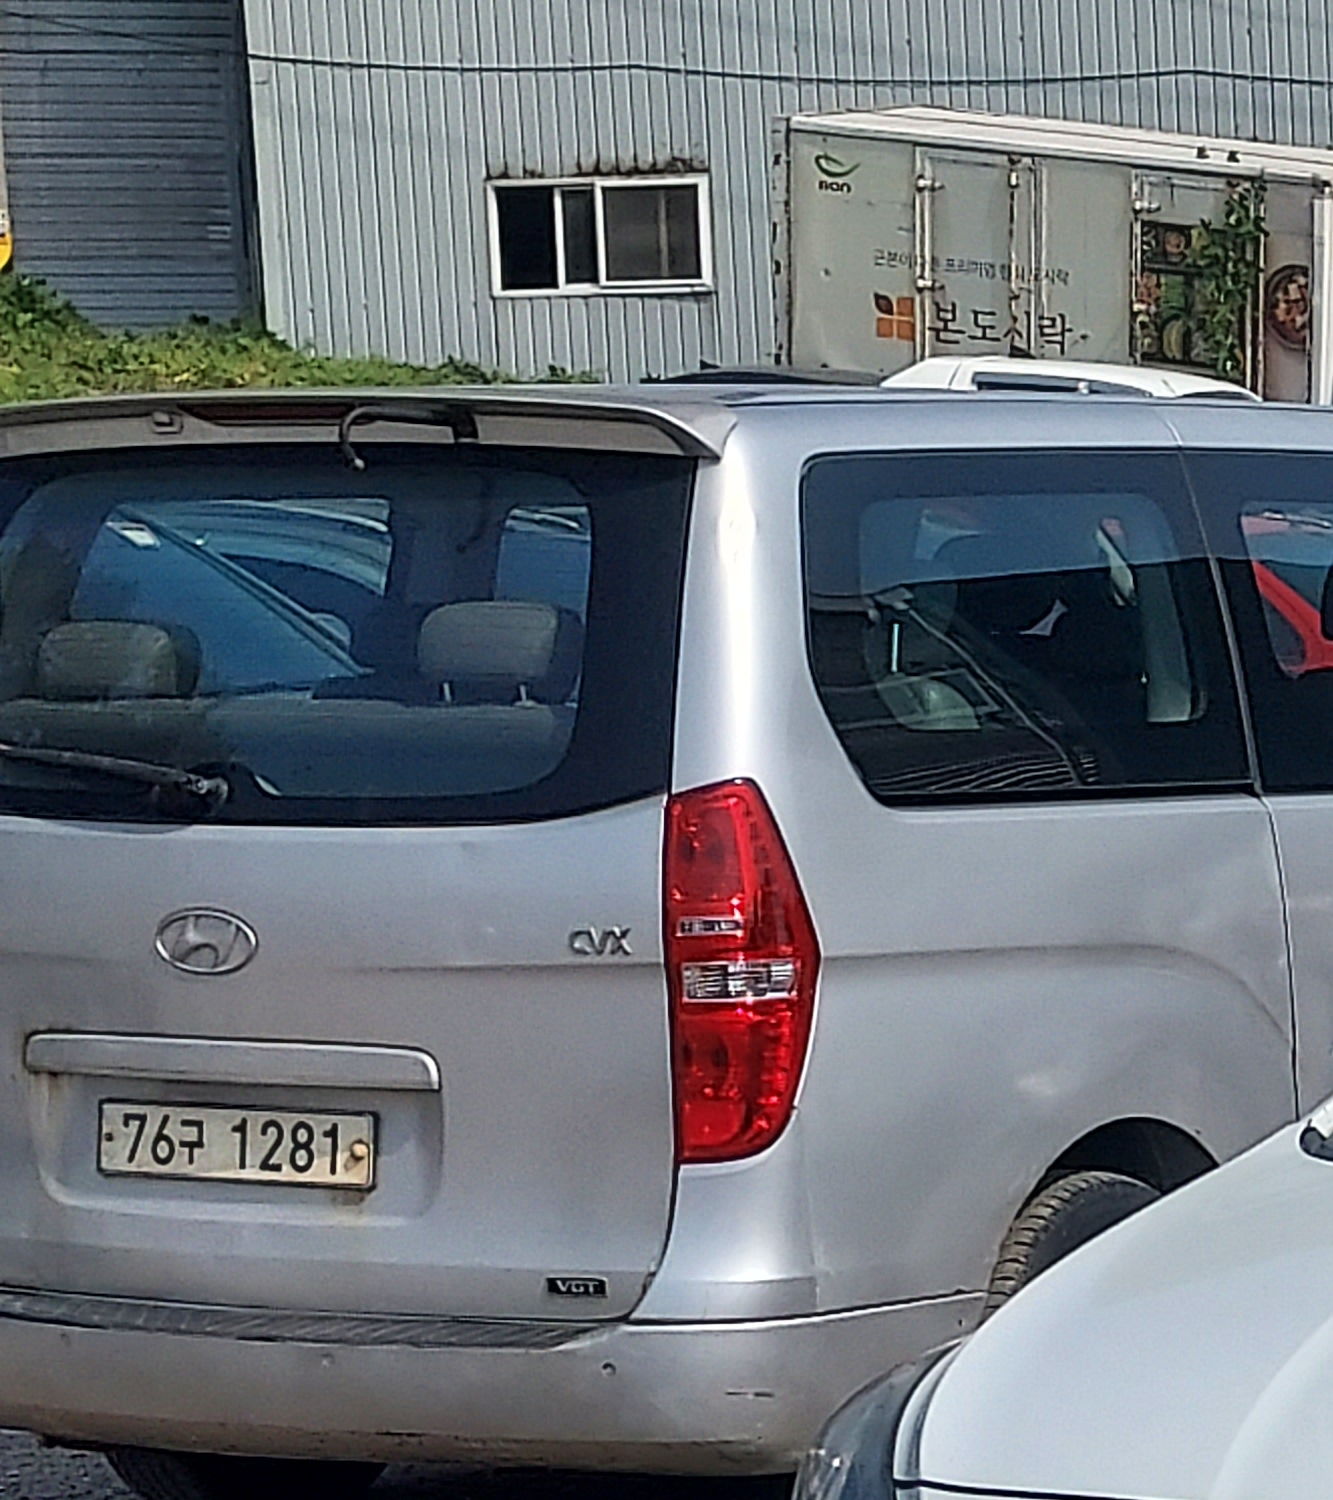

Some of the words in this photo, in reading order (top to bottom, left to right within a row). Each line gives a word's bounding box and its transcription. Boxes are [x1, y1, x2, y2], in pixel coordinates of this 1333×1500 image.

[927, 301, 1074, 355] 본도시락
[568, 925, 633, 956] CVX
[122, 1112, 205, 1166] 76구
[231, 1116, 339, 1176] 1281
[556, 1279, 600, 1294] VGT
